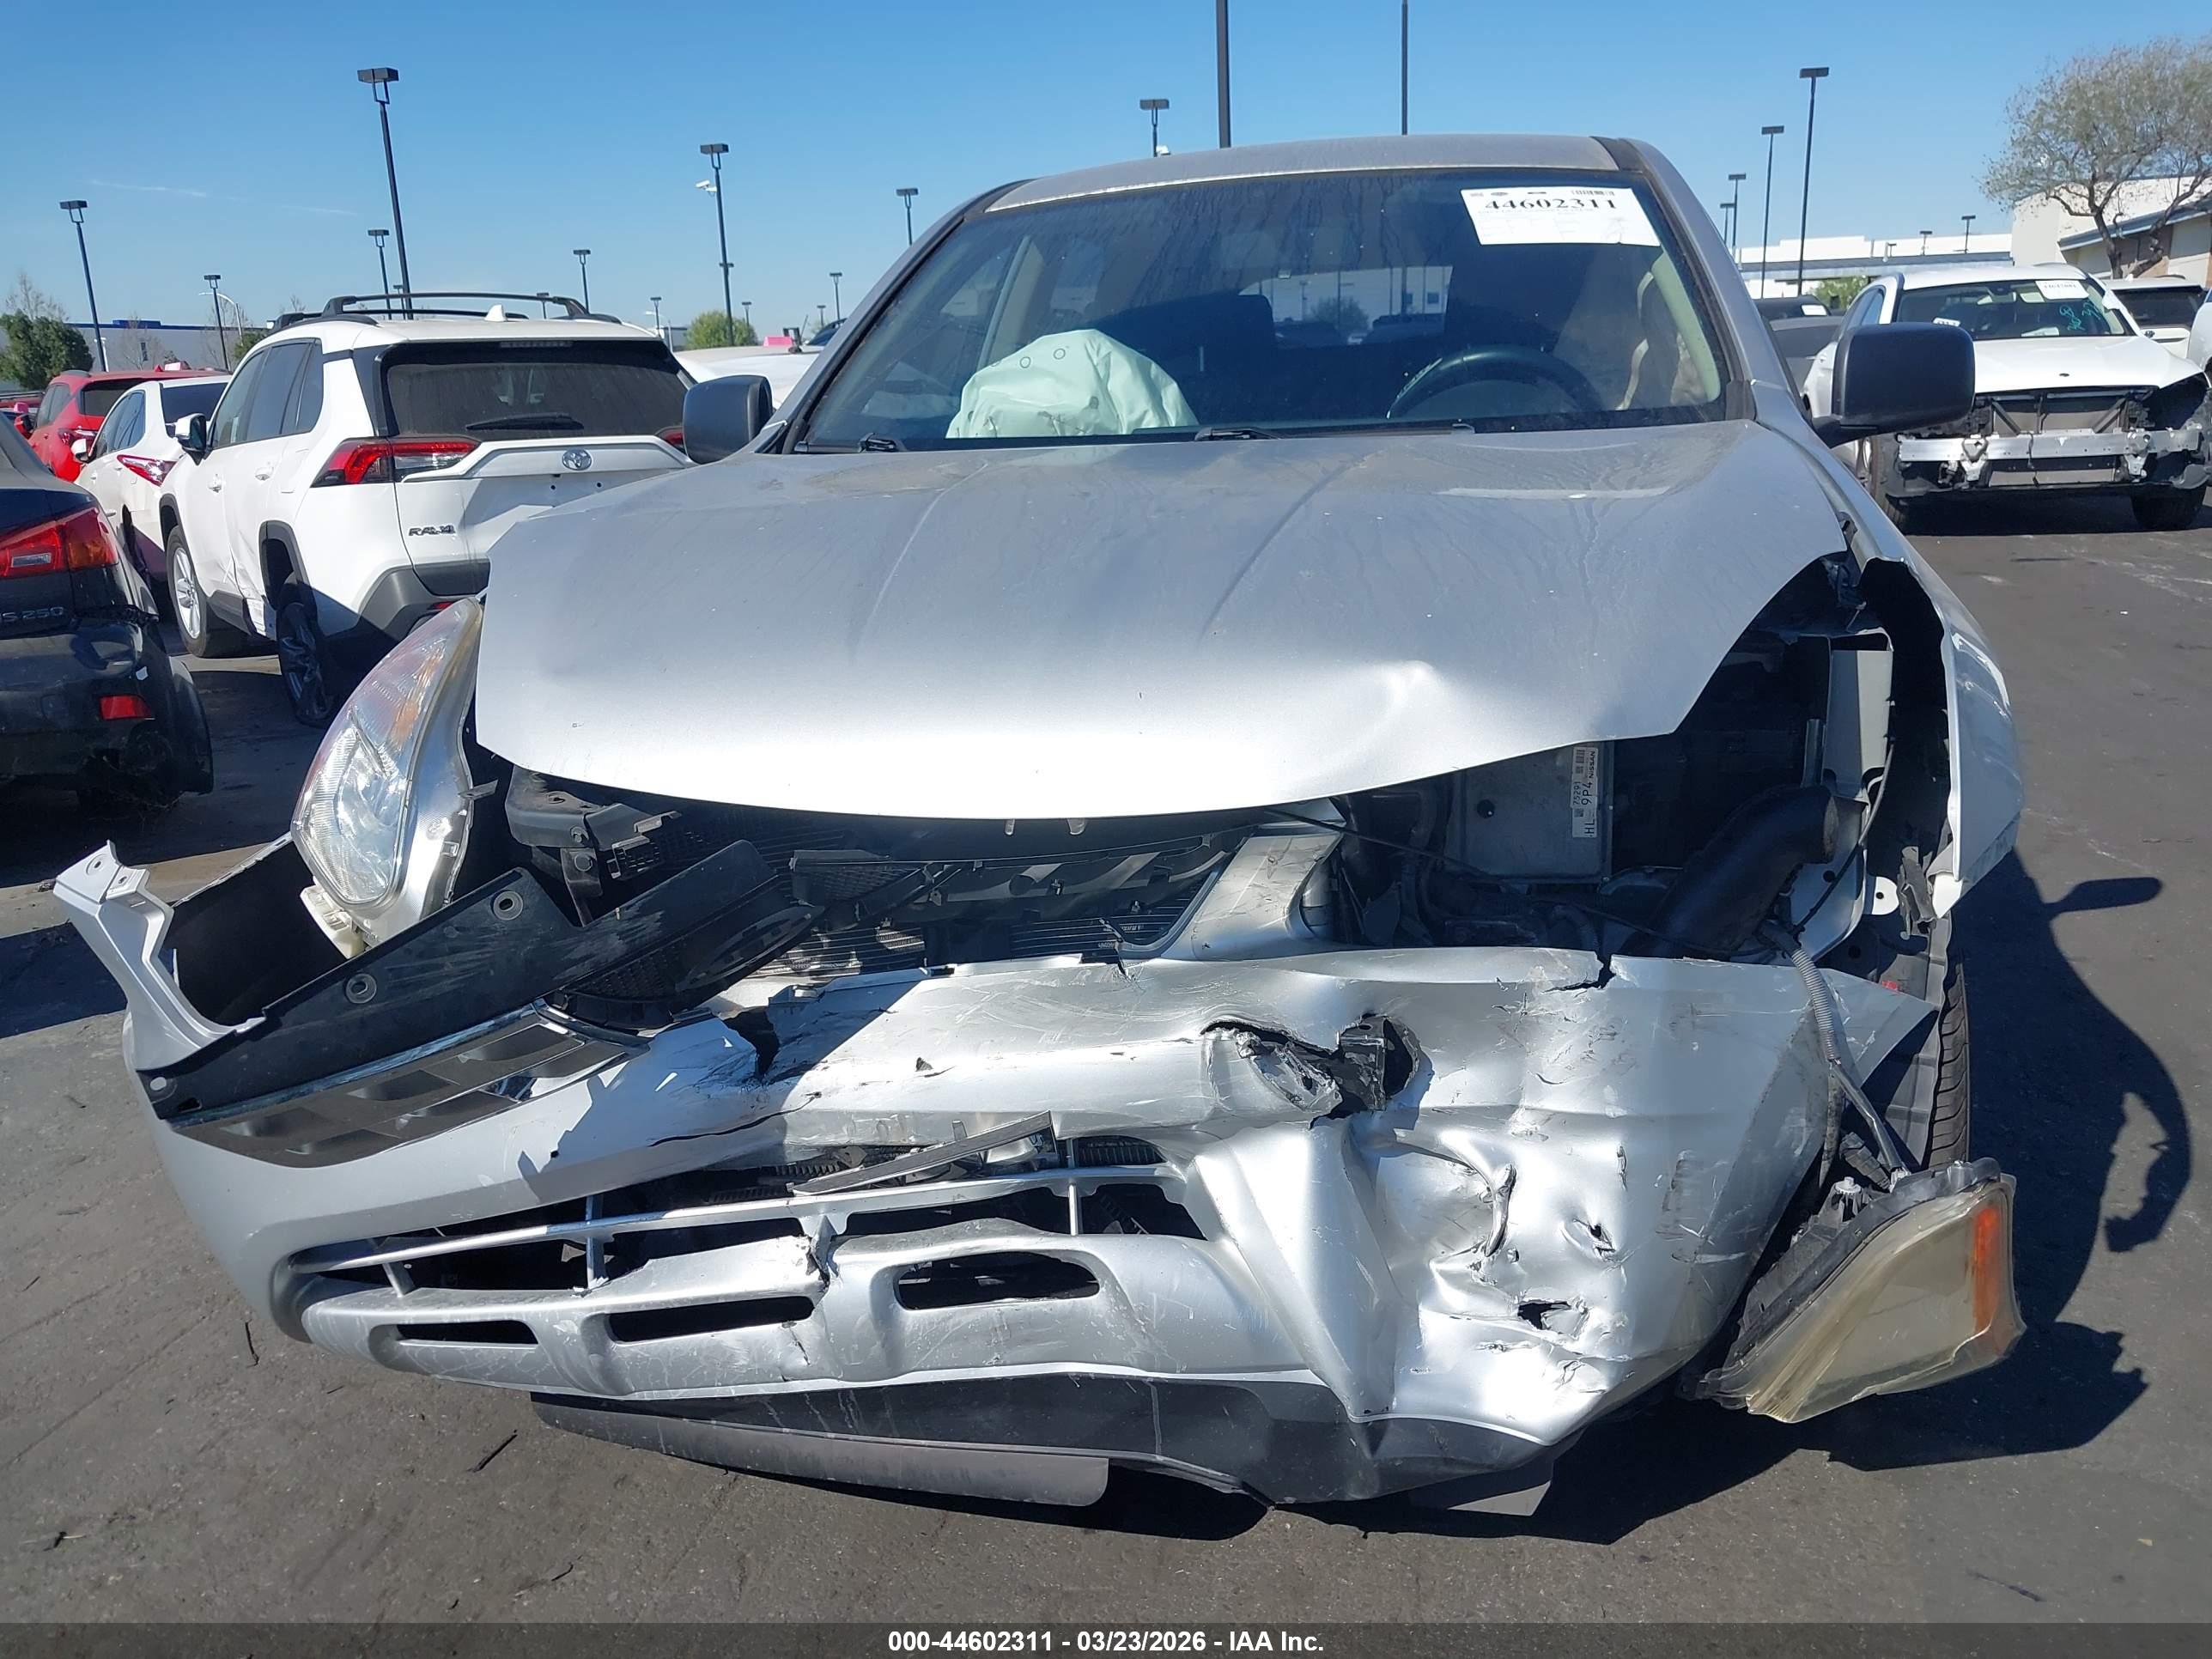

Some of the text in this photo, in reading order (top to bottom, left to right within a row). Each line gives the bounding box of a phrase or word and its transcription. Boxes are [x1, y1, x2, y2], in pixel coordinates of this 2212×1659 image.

[1486, 198, 1617, 210] 44602311
[408, 525, 456, 537] RAV4
[21, 606, 64, 619] 250
[1581, 781, 1592, 805] 9P4
[1587, 750, 1595, 779] NISSAN
